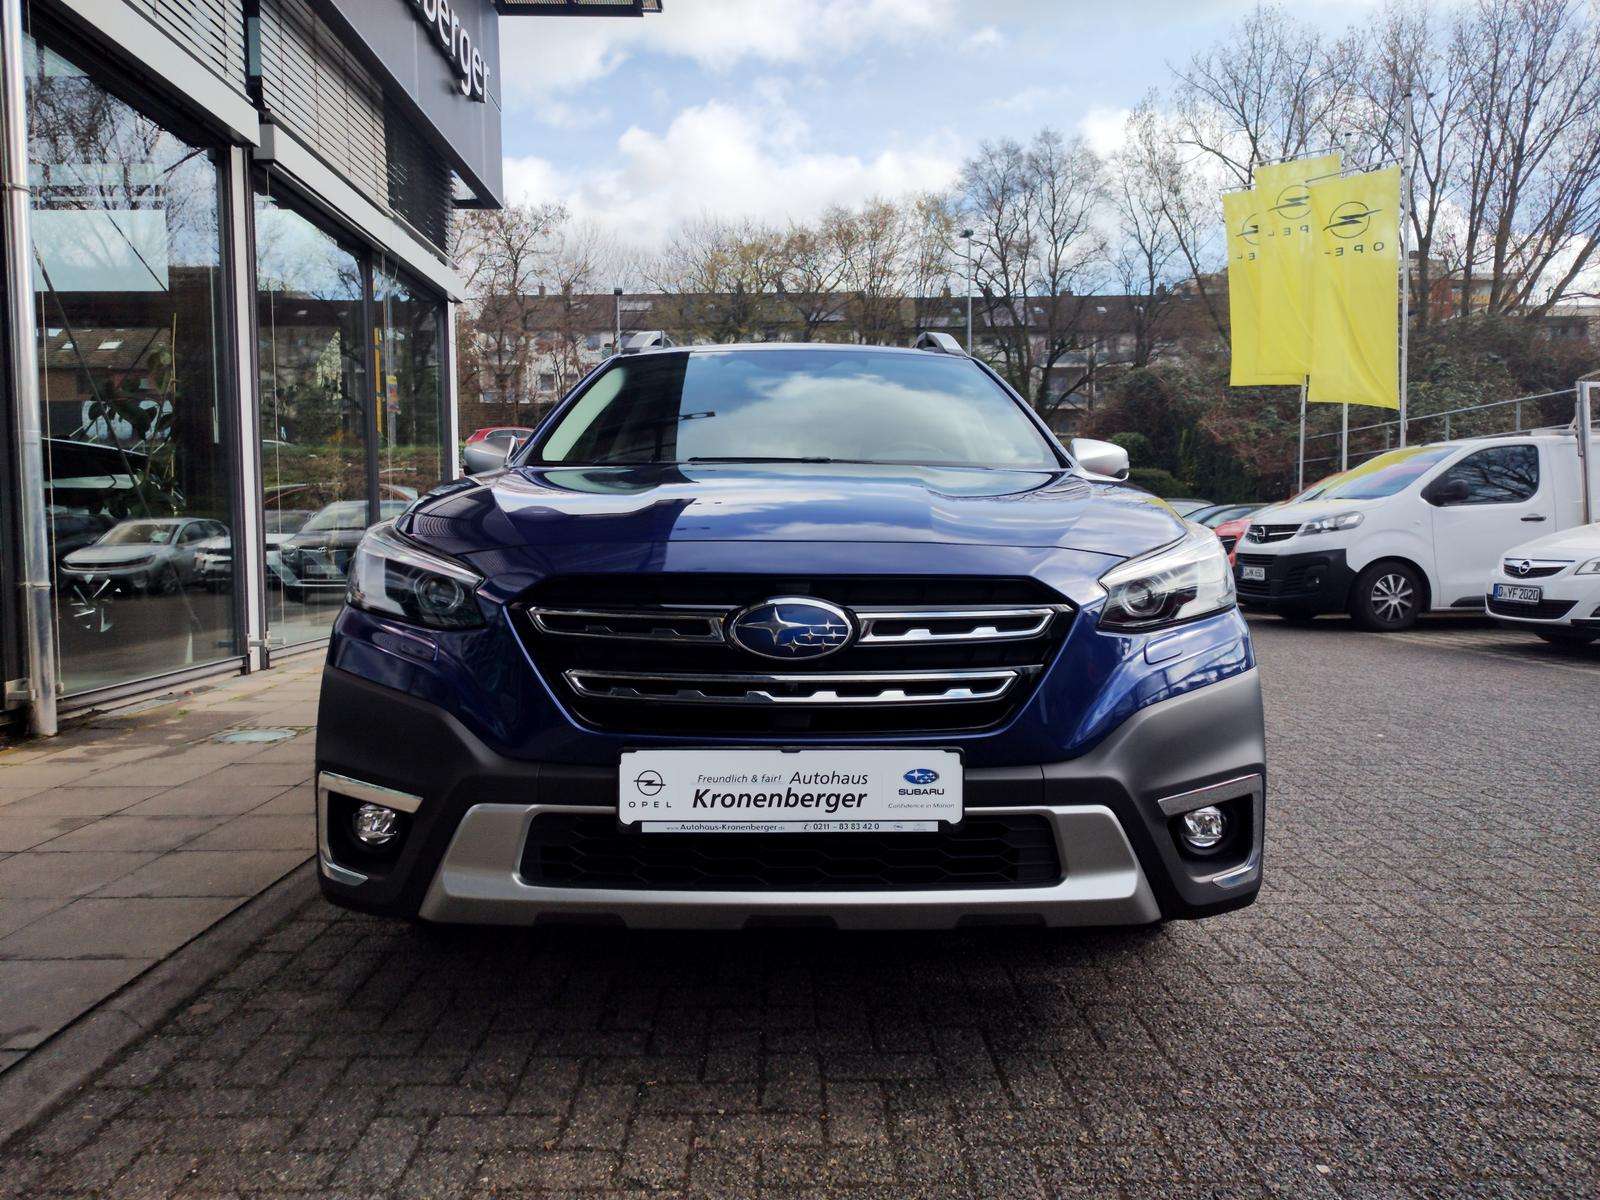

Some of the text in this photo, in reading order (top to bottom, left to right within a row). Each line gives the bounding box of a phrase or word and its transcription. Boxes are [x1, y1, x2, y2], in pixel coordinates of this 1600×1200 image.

[1508, 587, 1519, 599] YF
[1519, 589, 1539, 601] 2020
[697, 770, 869, 785] Freundlich & fair! Autohaus
[898, 788, 945, 796] SUBARU
[692, 787, 868, 814] Kronenberger
[812, 823, 830, 831] 0211
